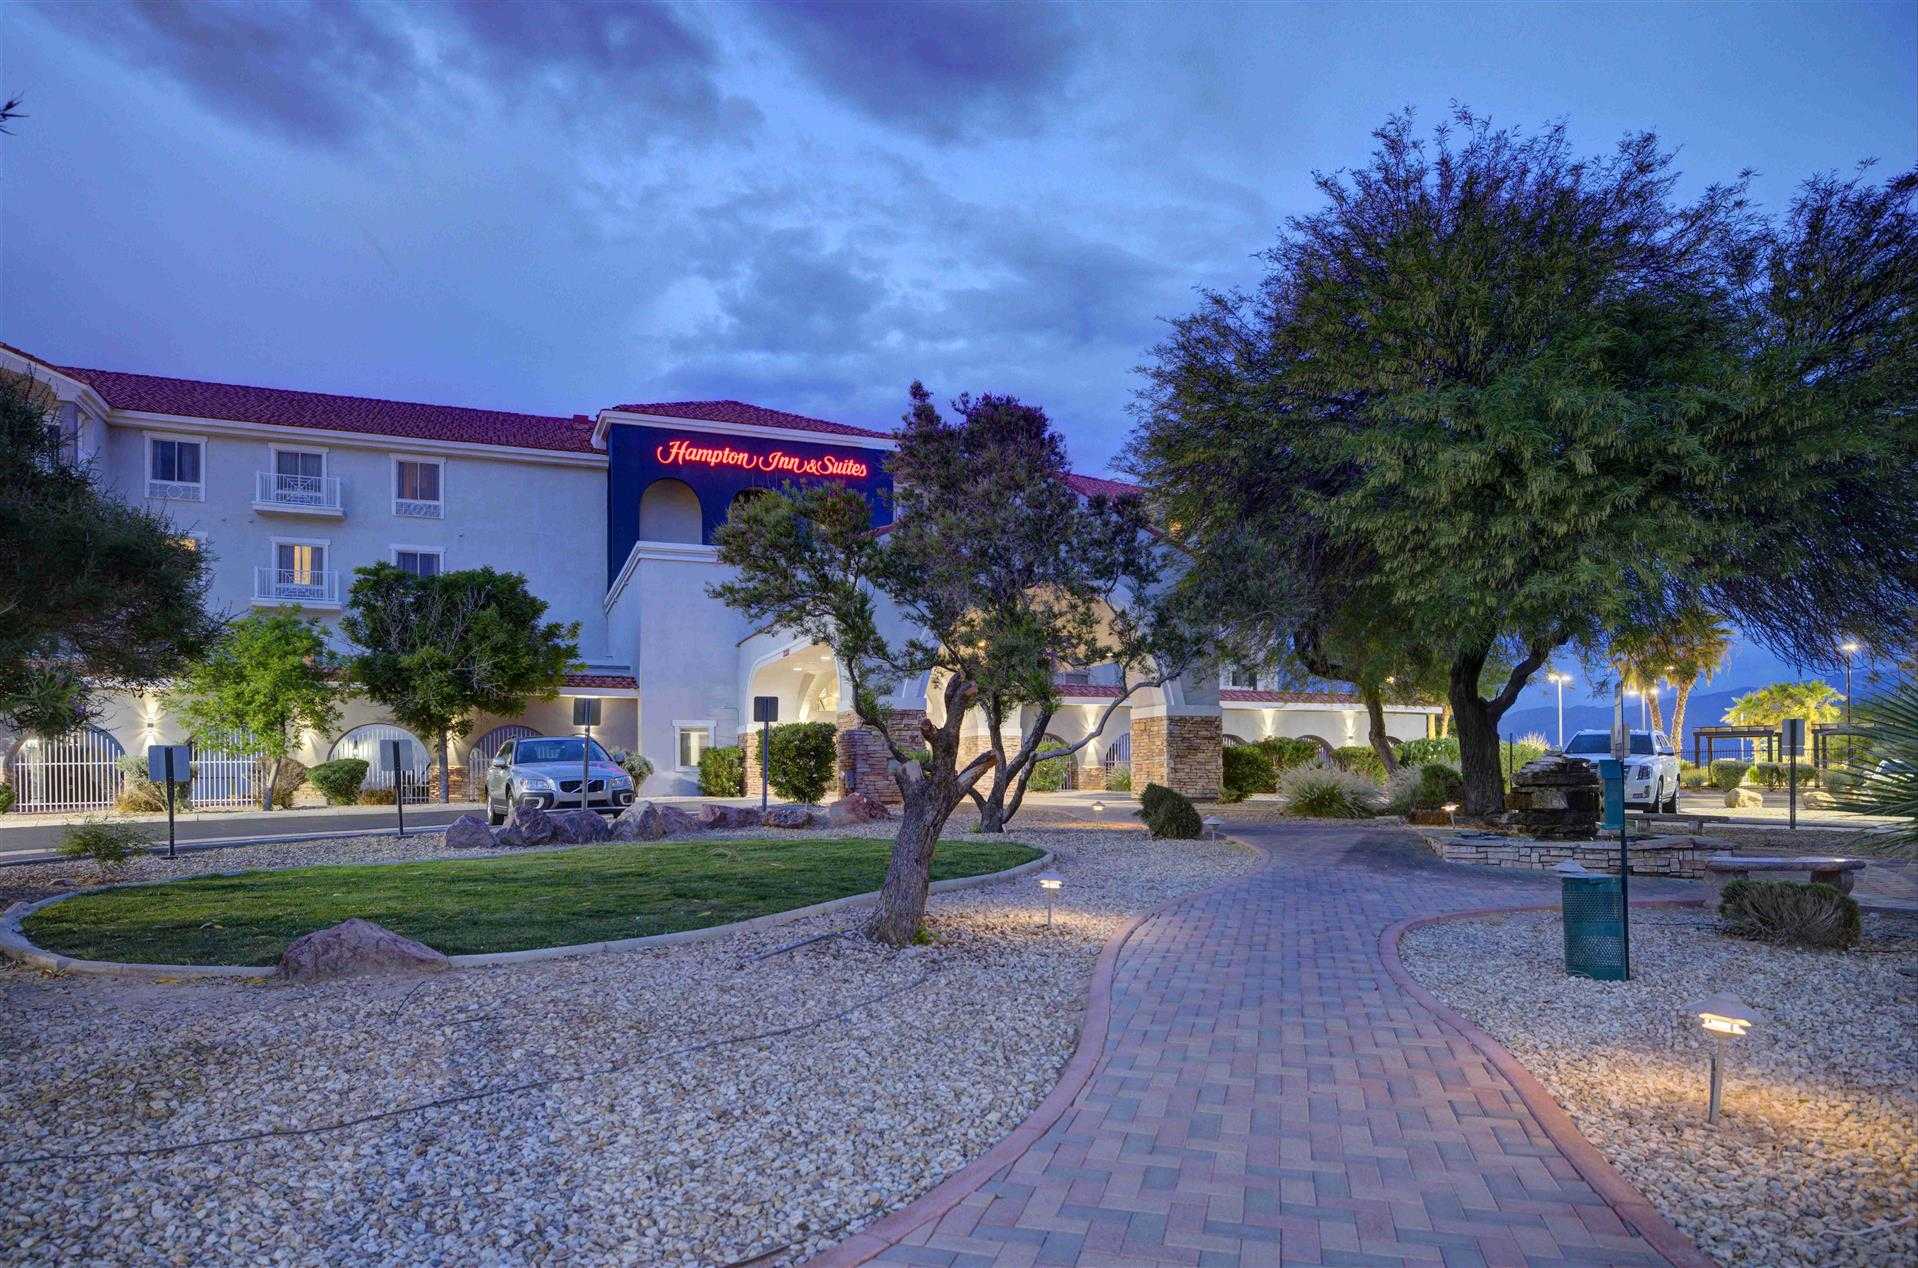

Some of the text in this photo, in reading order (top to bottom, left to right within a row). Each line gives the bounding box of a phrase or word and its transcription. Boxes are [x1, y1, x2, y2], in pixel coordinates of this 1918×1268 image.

[656, 440, 757, 469] Hampton
[759, 451, 807, 473] Inn
[817, 456, 867, 477] Suites
